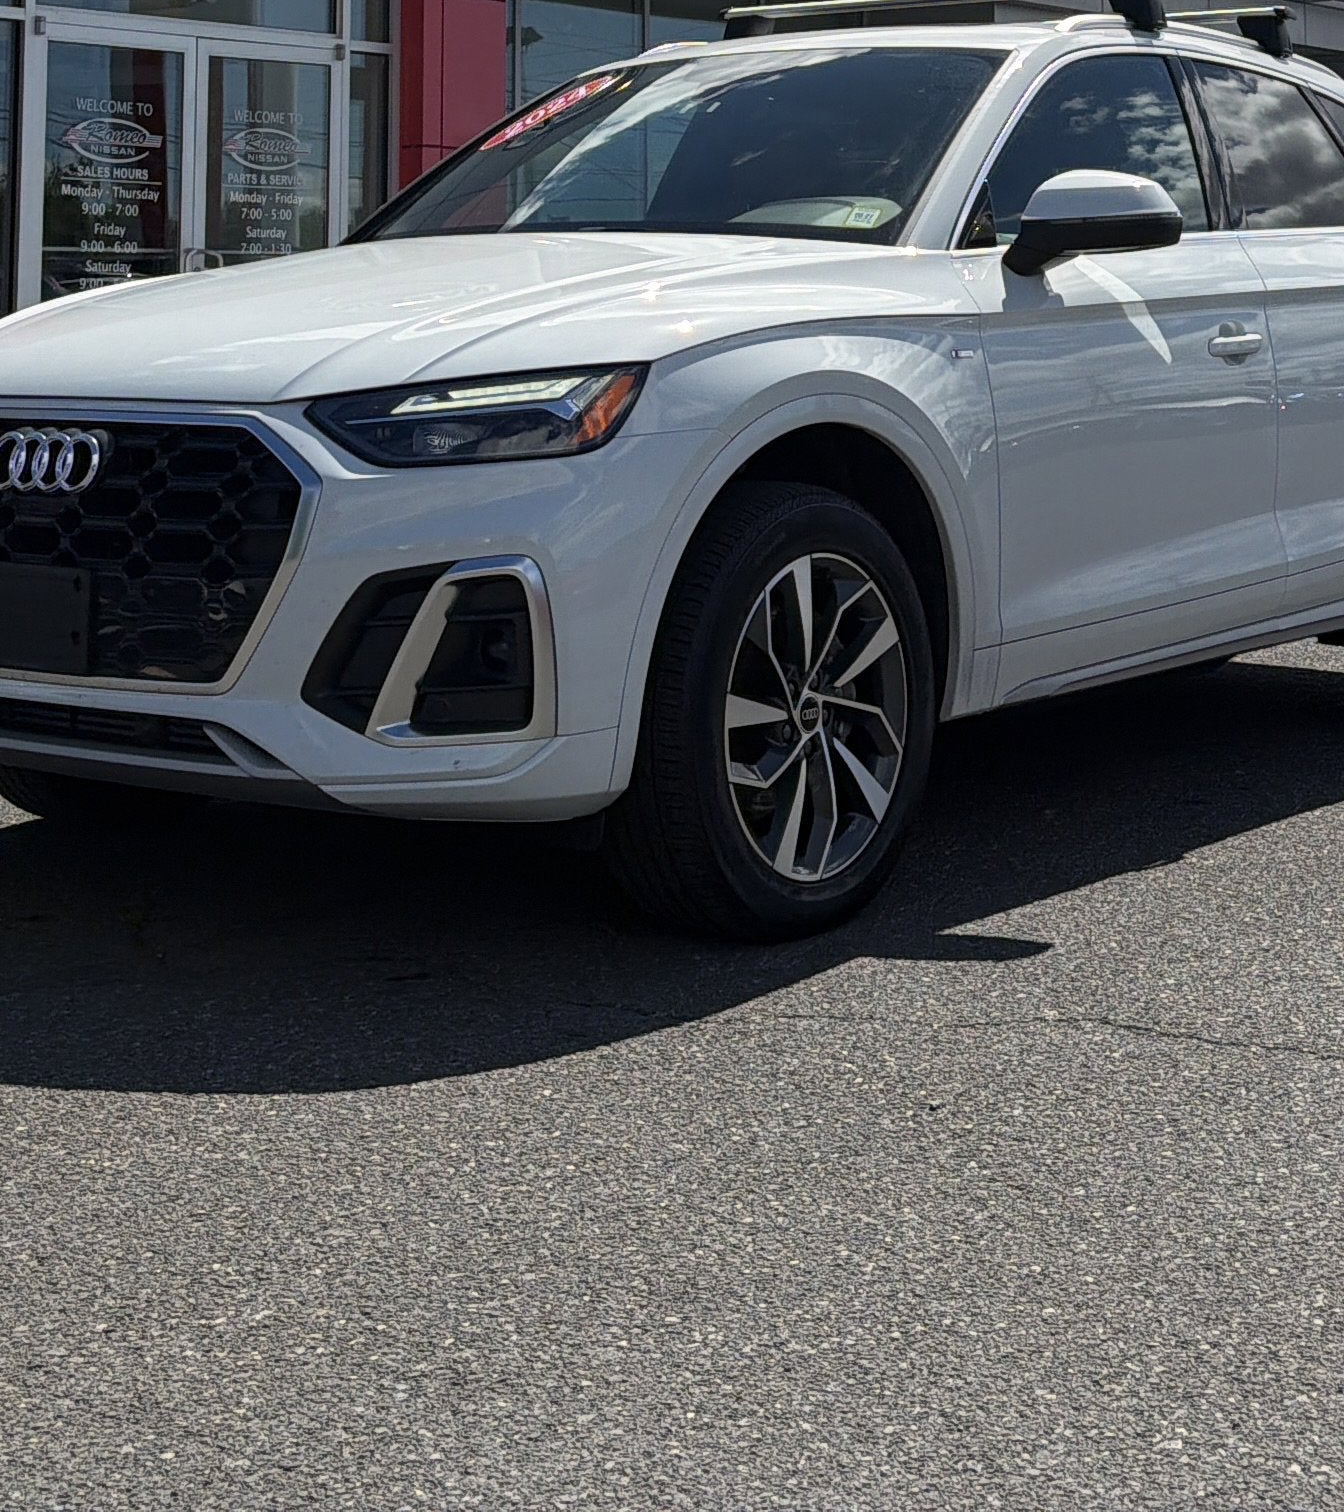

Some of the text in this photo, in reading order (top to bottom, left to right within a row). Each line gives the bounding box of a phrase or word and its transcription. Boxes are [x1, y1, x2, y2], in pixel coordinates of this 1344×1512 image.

[76, 97, 154, 117] WELCOME TO
[504, 85, 587, 138] 2024
[234, 109, 304, 126] WELCOME TO
[80, 121, 147, 145] Romeo
[243, 131, 298, 153] Romeo
[90, 145, 136, 156] NISSAN
[247, 153, 288, 163] NISSAN
[77, 165, 149, 180] SALES HOURS
[227, 172, 305, 187] PARTS & SERVIC
[61, 183, 103, 200] Monday
[112, 185, 160, 203] Thursday
[229, 191, 268, 206] Monday
[275, 192, 304, 206] Friday
[81, 202, 106, 215] 9:00
[115, 203, 139, 217] 7:00
[240, 207, 263, 220] 7:00
[271, 208, 293, 221] 5:00
[94, 222, 127, 238] Friday
[245, 225, 288, 240] Saturday
[80, 240, 105, 253] 9:00
[114, 240, 138, 254] 6:00
[240, 242, 262, 255] 7:00
[271, 242, 292, 256] 1:30
[85, 259, 132, 274] Saturday
[79, 277, 104, 289] 9:00
